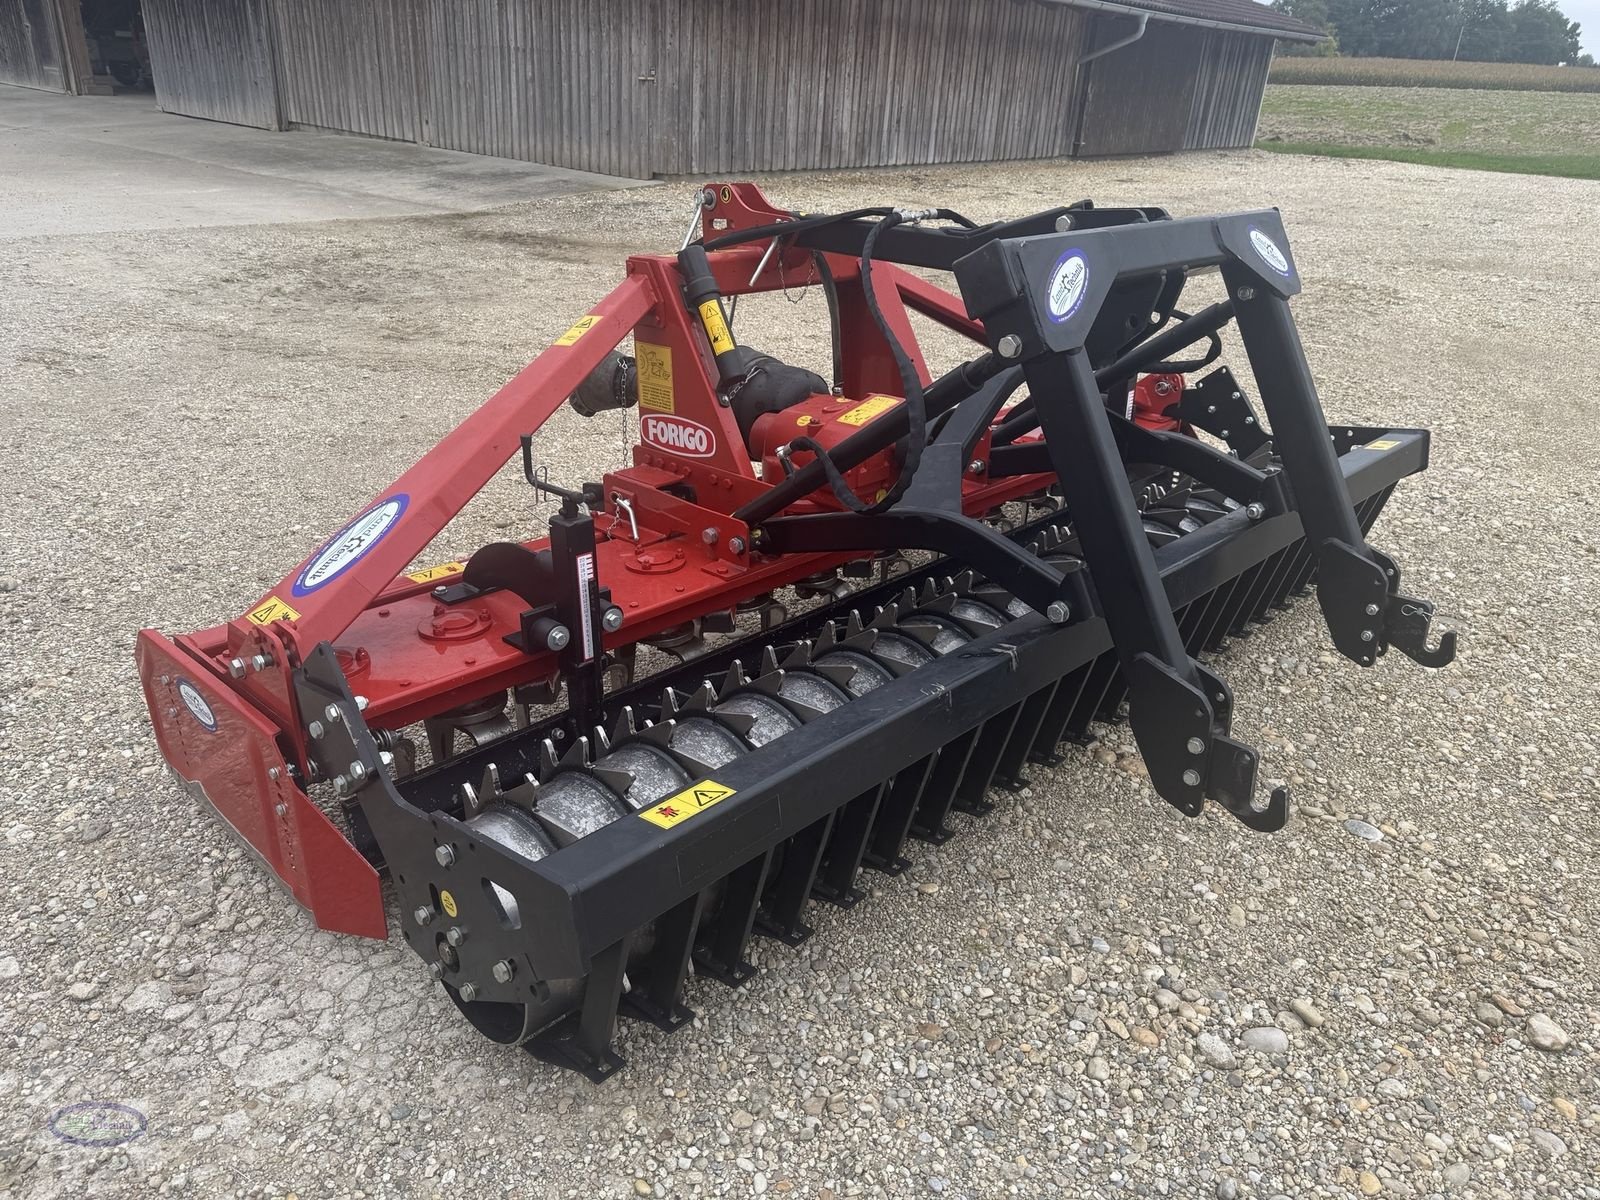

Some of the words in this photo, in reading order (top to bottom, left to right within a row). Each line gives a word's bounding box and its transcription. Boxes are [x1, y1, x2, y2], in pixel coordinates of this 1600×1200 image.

[647, 418, 708, 453] FORIGO
[362, 513, 391, 537] Land
[309, 543, 354, 580] Technik
